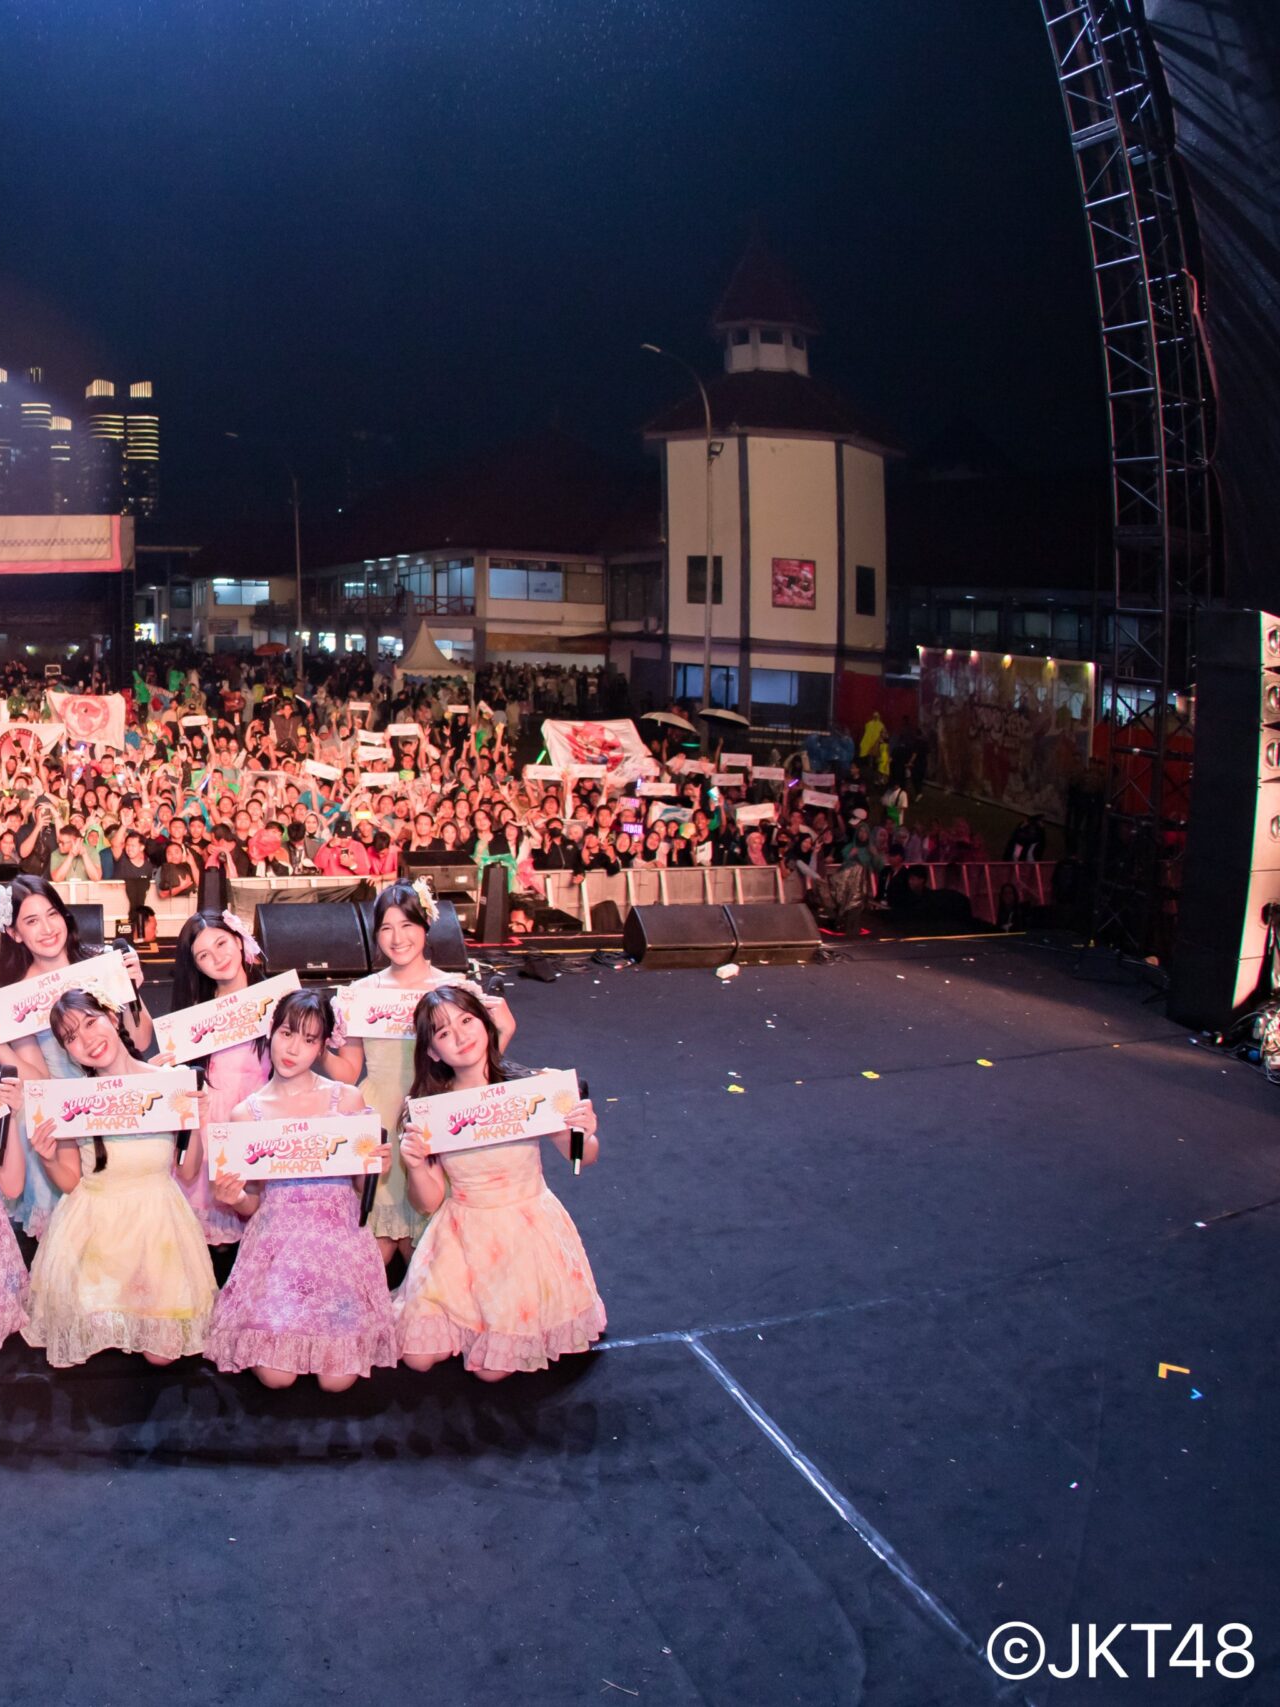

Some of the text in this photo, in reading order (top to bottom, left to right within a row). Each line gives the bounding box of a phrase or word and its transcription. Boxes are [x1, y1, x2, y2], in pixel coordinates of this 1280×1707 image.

[38, 973, 61, 989] JKT48
[216, 995, 238, 1010] JKT48
[212, 1025, 261, 1047] JAKARTA
[96, 1078, 123, 1092] JKT48
[480, 1086, 506, 1101] JKT48
[60, 1094, 110, 1122] SOUNDS
[111, 1105, 140, 1115] 2025
[85, 1116, 139, 1131] JAKARTA
[448, 1103, 495, 1136] SOUNDS
[496, 1111, 523, 1124] 2025
[282, 1122, 309, 1135] JKT48
[472, 1123, 525, 1142] JAKARTA
[243, 1138, 294, 1165] SOUNDS
[295, 1148, 324, 1159] 2025
[269, 1160, 323, 1174] JAKARTA
